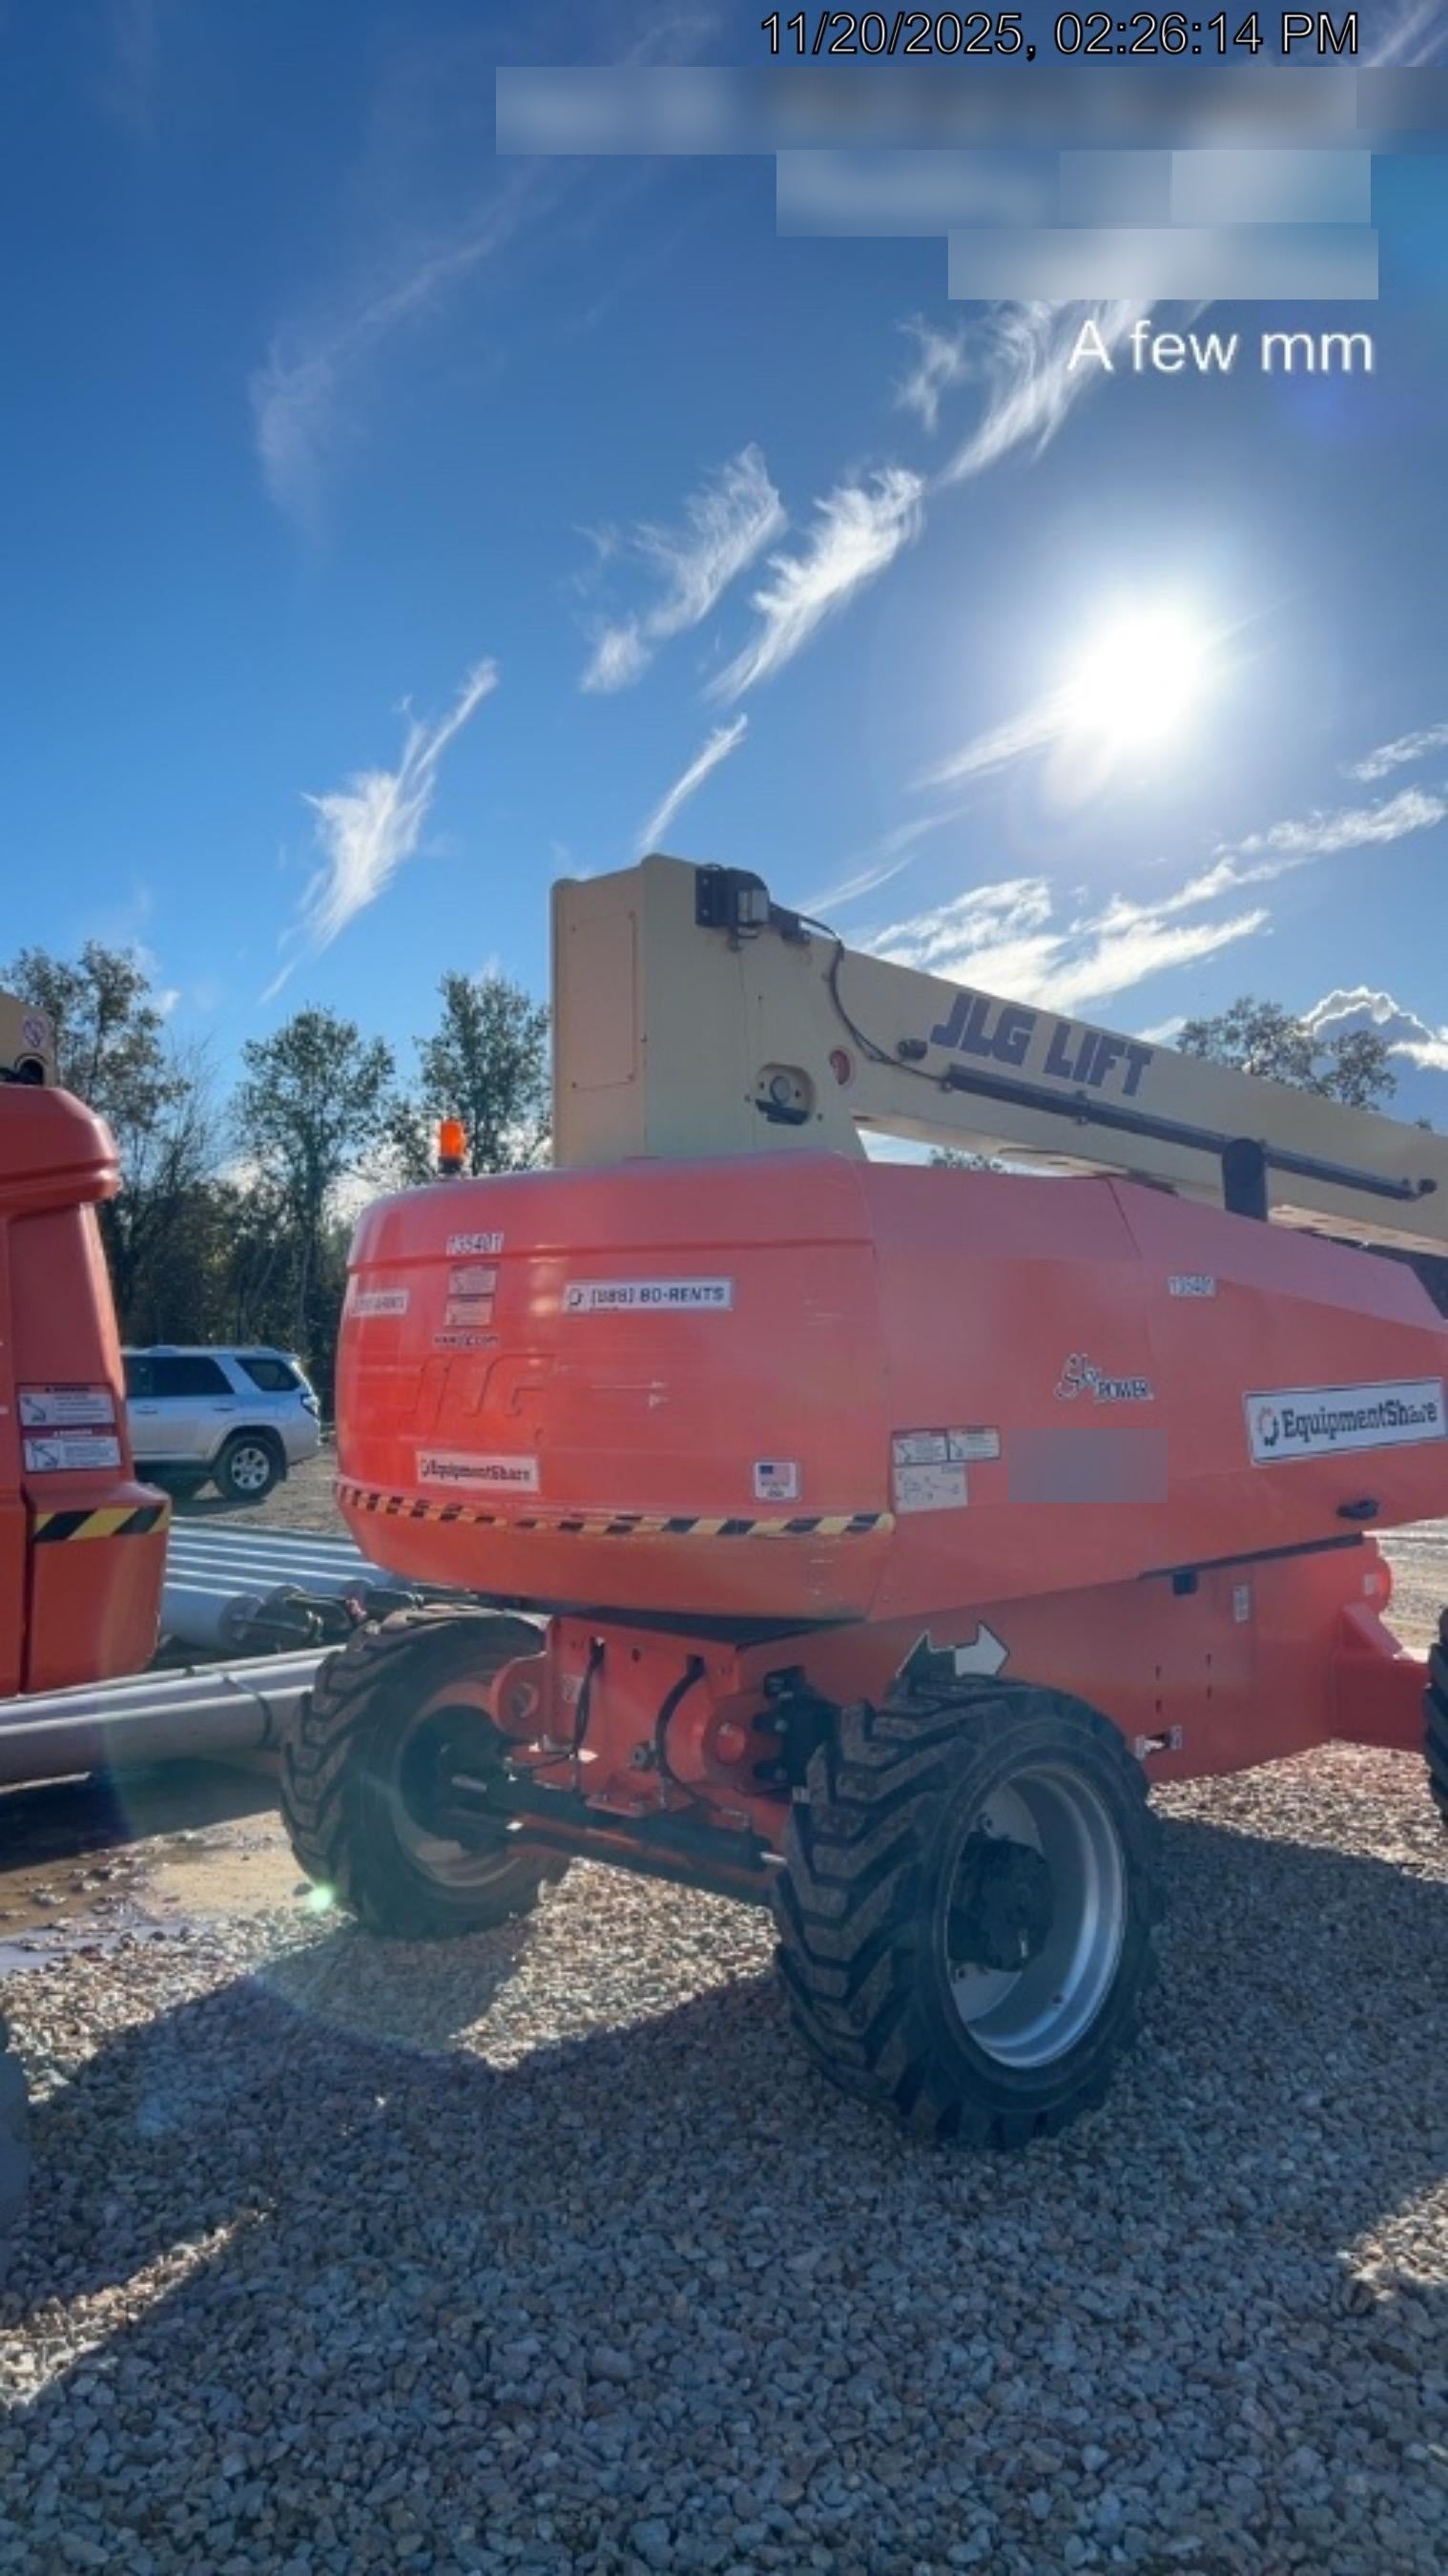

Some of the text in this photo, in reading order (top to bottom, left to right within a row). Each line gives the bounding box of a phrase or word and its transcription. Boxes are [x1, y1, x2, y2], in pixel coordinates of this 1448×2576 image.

[930, 992, 1153, 1096] JLG LIFT
[1281, 1400, 1438, 1443] EquipmentShare
